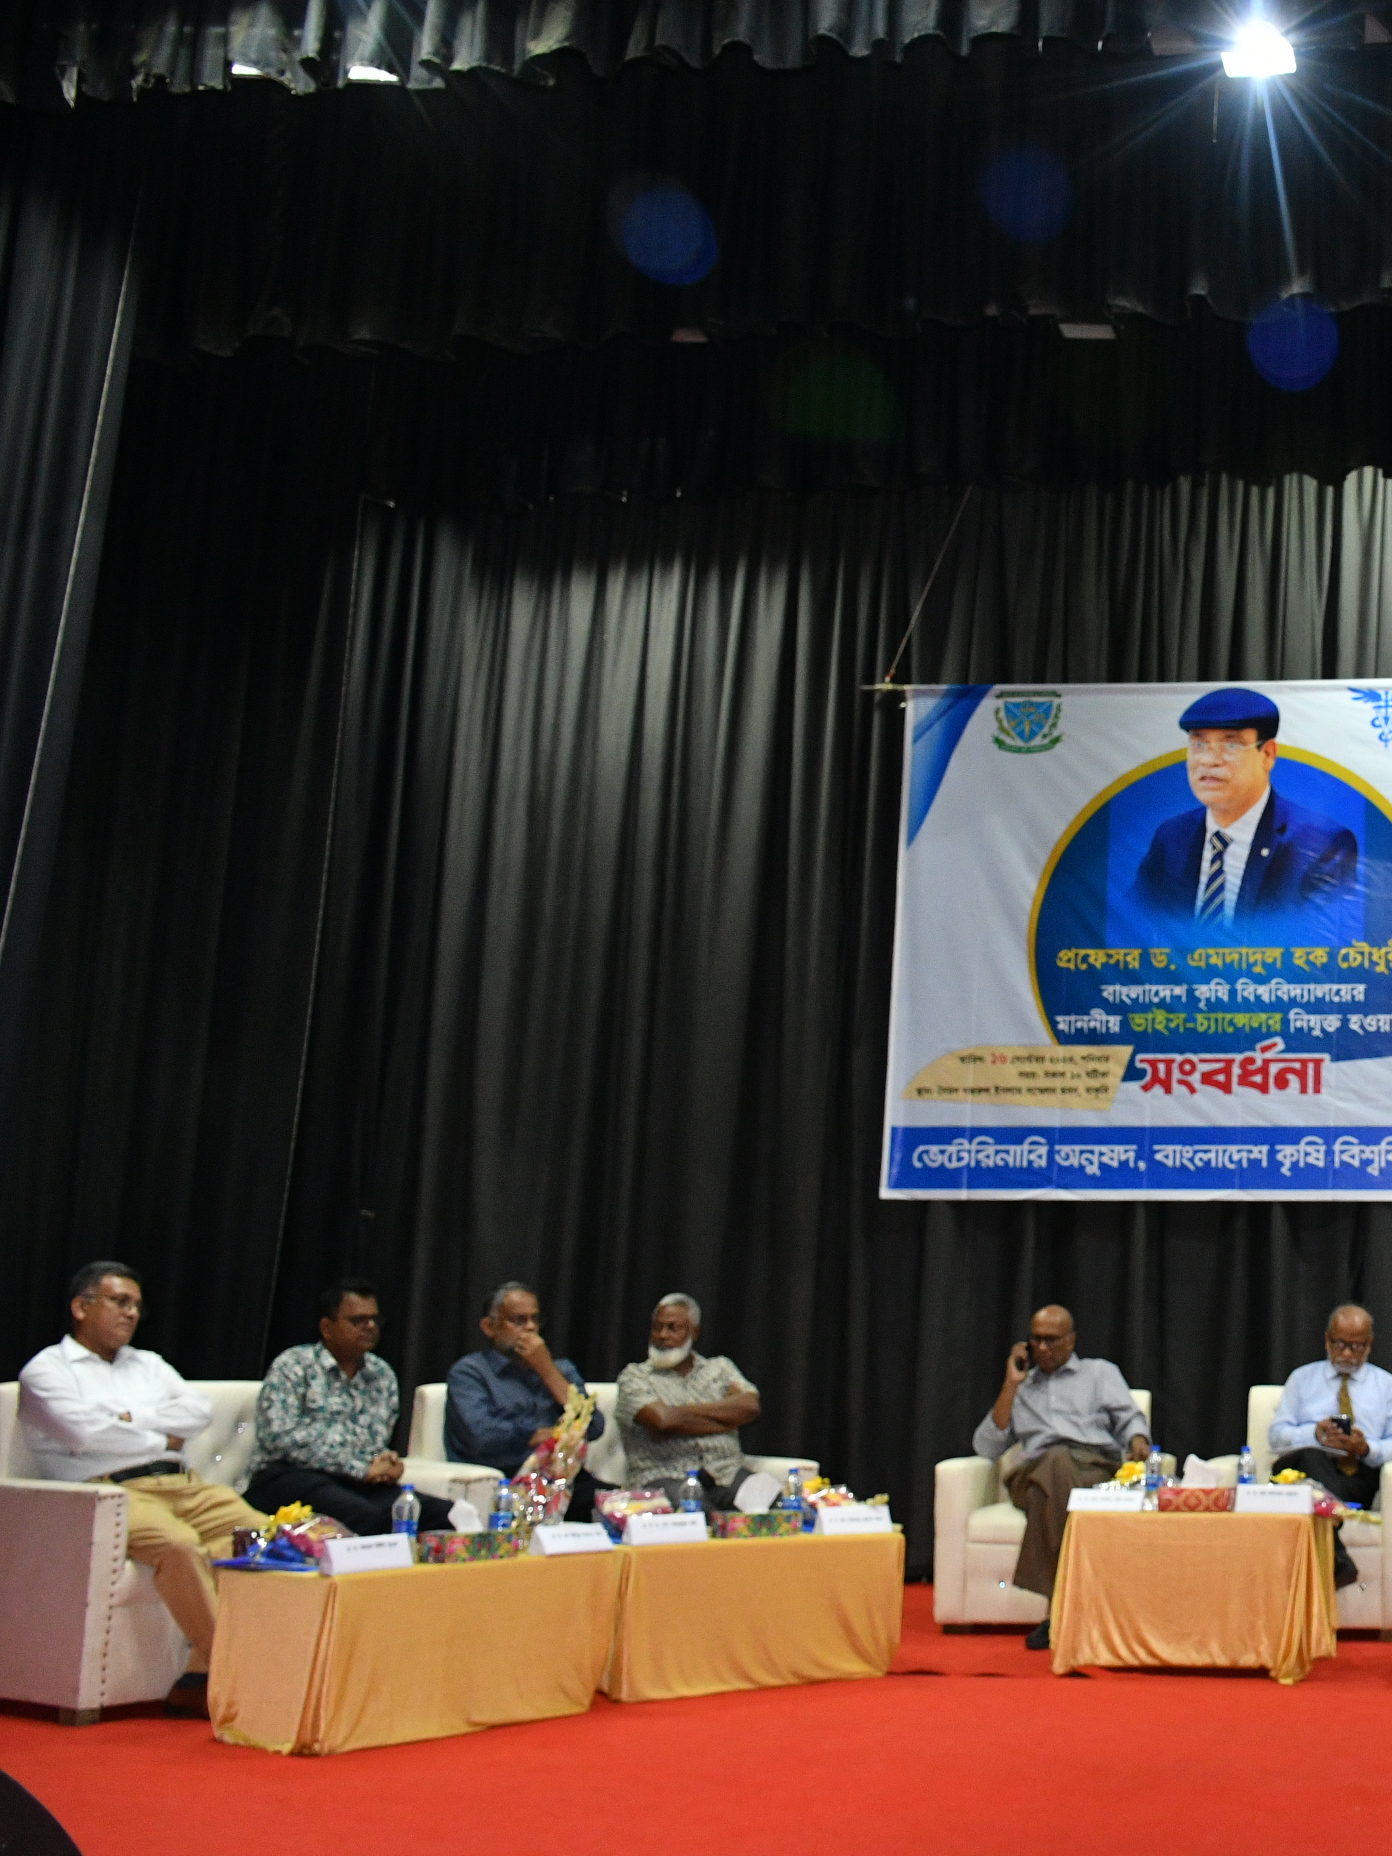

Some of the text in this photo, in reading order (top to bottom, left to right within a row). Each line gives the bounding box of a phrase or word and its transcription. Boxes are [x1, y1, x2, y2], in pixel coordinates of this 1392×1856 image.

[1056, 947, 1142, 971] প্রফেসর
[1150, 947, 1176, 971] ড.
[1188, 946, 1283, 976] এমদাদুল
[1292, 946, 1330, 970] হক
[1101, 978, 1367, 1012] বাংলাদেশ কৃষি বিশ্ববিদ্যালয়ের
[1054, 1008, 1122, 1036] মাননীয়
[1127, 1006, 1284, 1036] ভাইস-চ্যান্সেলর
[1288, 1006, 1342, 1038] নিযুক্ত
[1138, 1042, 1326, 1096] সংবর্ধনা
[912, 1135, 1050, 1170] ভেটেরিনারি
[1054, 1144, 1148, 1176] অনুষদ,
[1152, 1144, 1270, 1172] বাংলাদেশ
[1274, 1136, 1326, 1177] কৃষি
